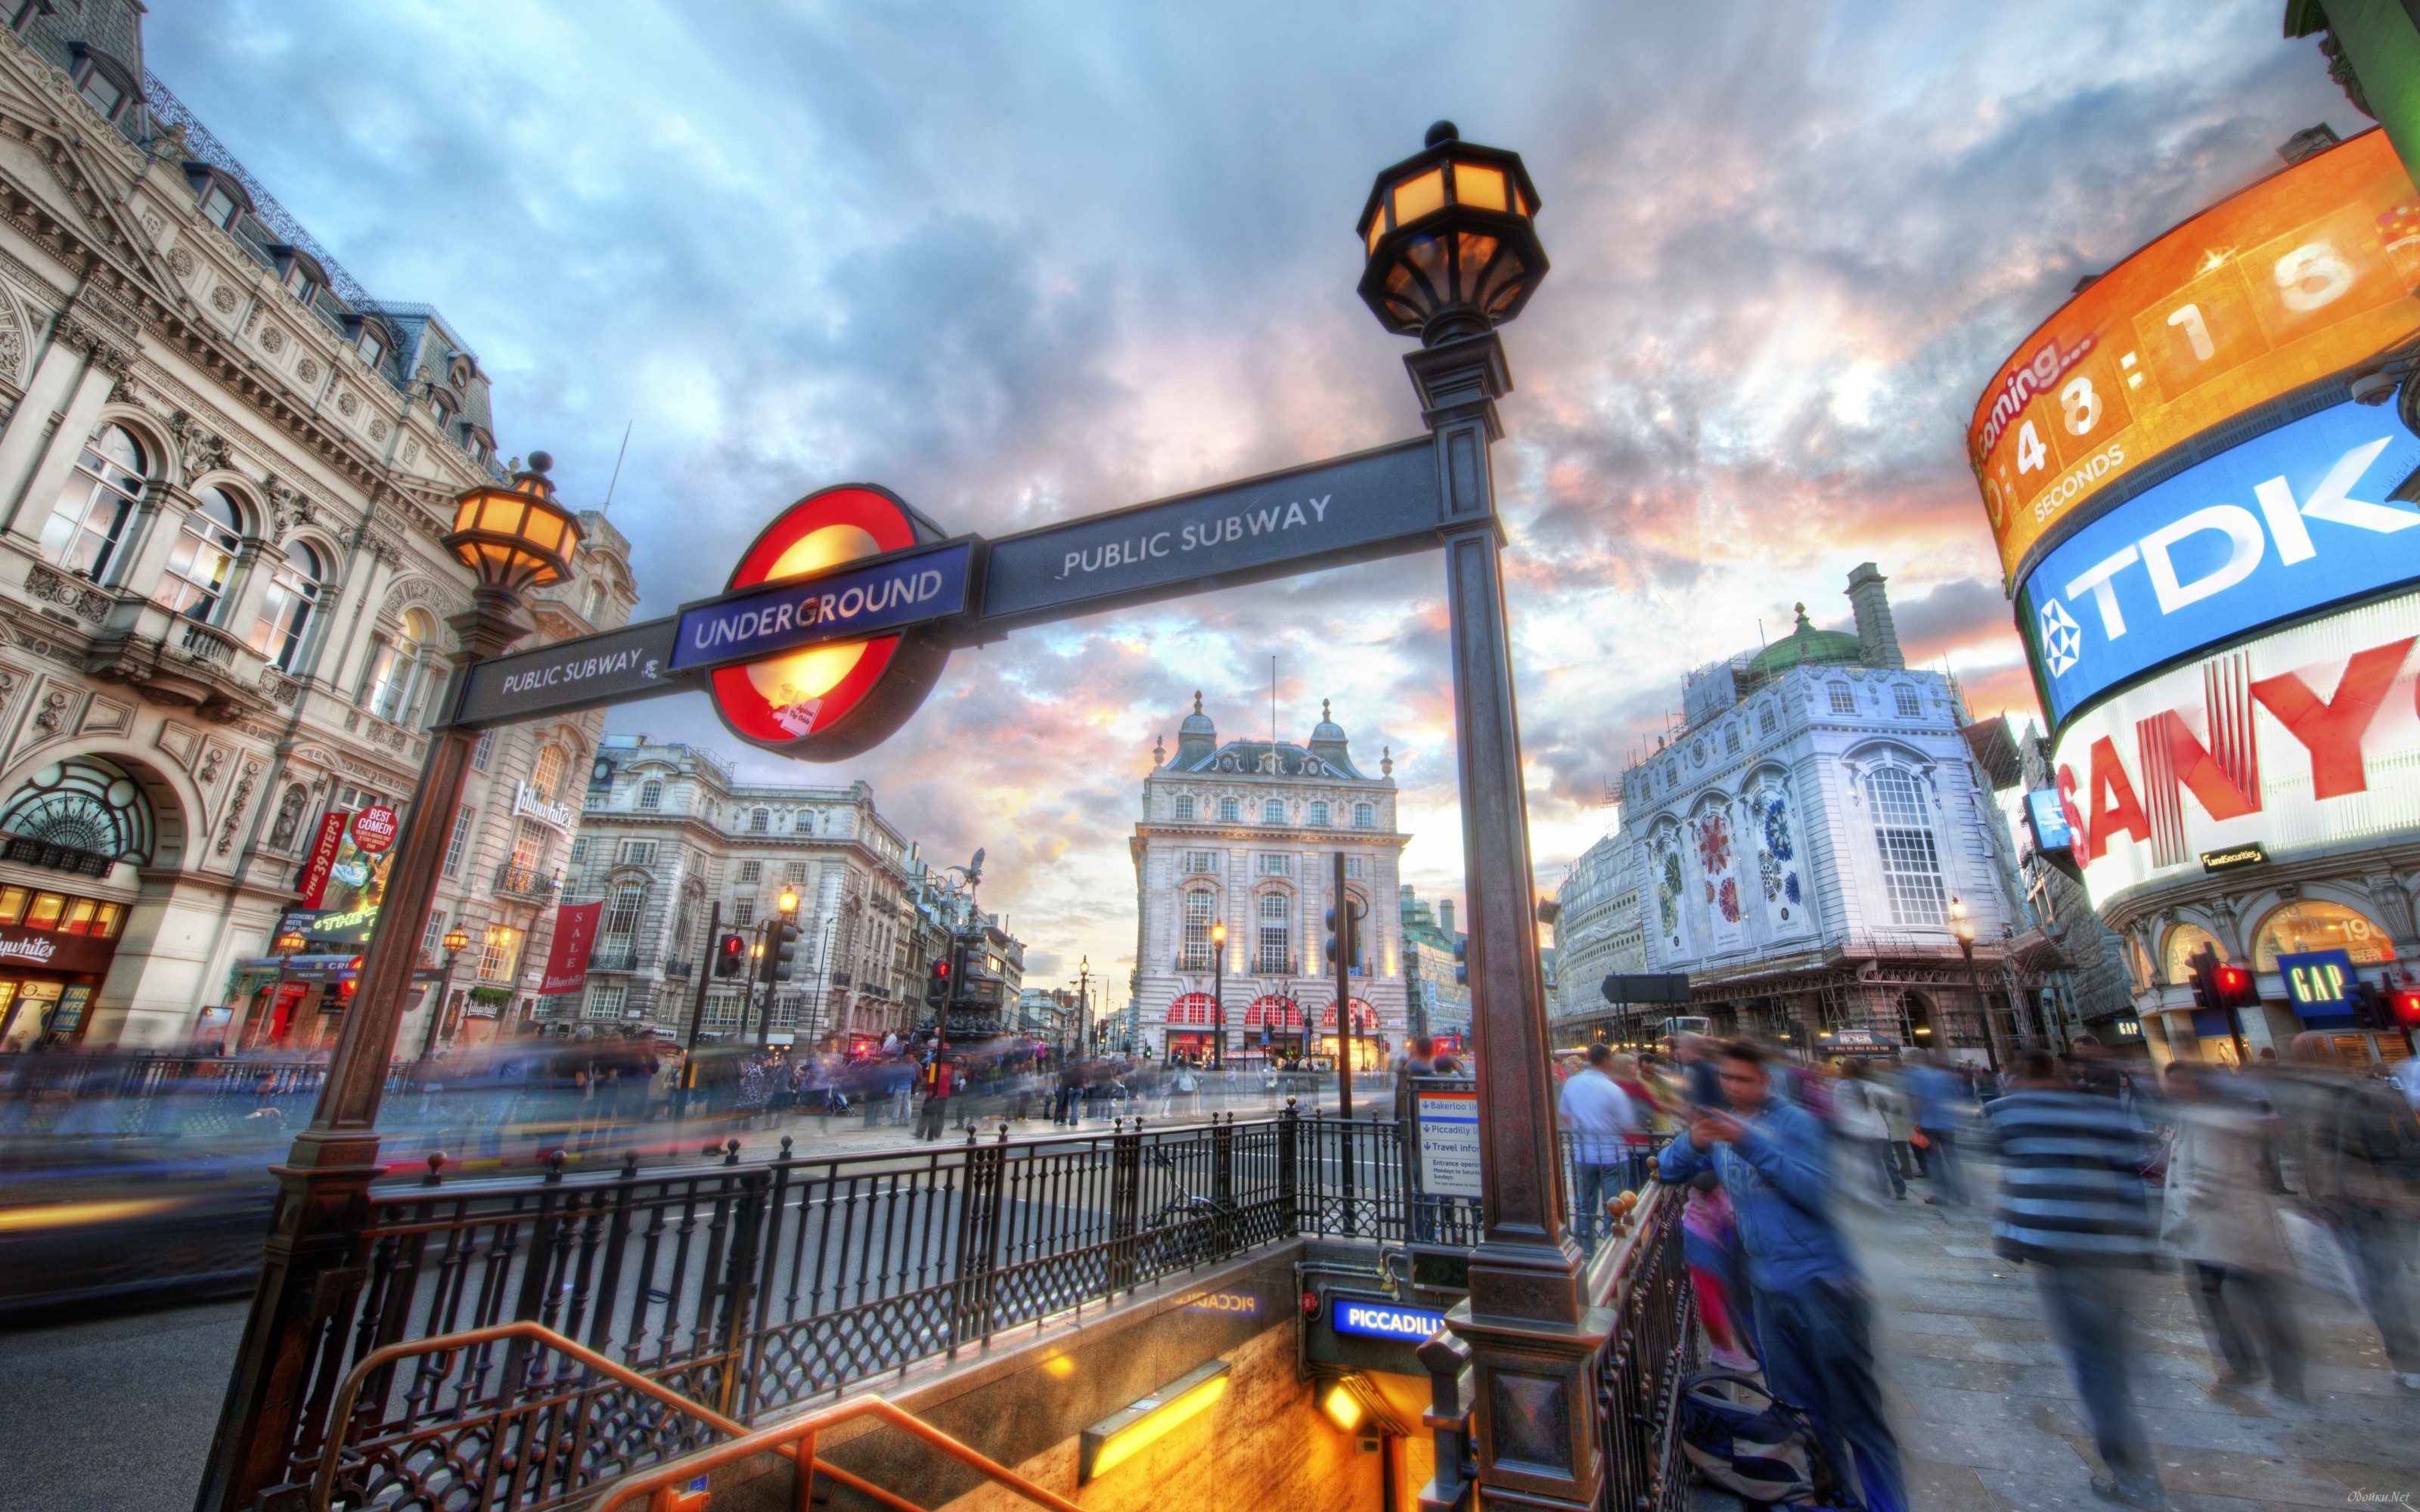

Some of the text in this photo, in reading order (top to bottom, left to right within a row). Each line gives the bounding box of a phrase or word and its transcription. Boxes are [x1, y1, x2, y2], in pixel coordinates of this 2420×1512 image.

[2034, 443, 2126, 523] SECONDS
[1061, 494, 1333, 578] PUBLIC SUBWAY
[2065, 435, 2420, 641] TDK
[694, 569, 943, 649] UNDERGROUND
[502, 648, 642, 694] PUBLIC SUBWAY
[790, 710, 798, 720] The
[2057, 635, 2420, 871] SANY
[370, 808, 392, 823] BEST
[513, 779, 573, 835] Lillywhites
[358, 818, 394, 835] COMEDY
[315, 856, 329, 876] 39
[2207, 850, 2257, 866] LandSecurities
[566, 912, 583, 968] SALE
[544, 975, 582, 989] Lillywhites
[2291, 965, 2344, 1003] GAP
[64, 987, 92, 999] THIS
[59, 1001, 84, 1013] WEE
[467, 1000, 498, 1018] Lillywhites
[2119, 1022, 2138, 1035] GAP
[1431, 1101, 1466, 1111] Bakerloo
[1432, 1125, 1471, 1136] Piccadilly
[1432, 1142, 1458, 1151] Travel
[1433, 1159, 1459, 1167] Entrance
